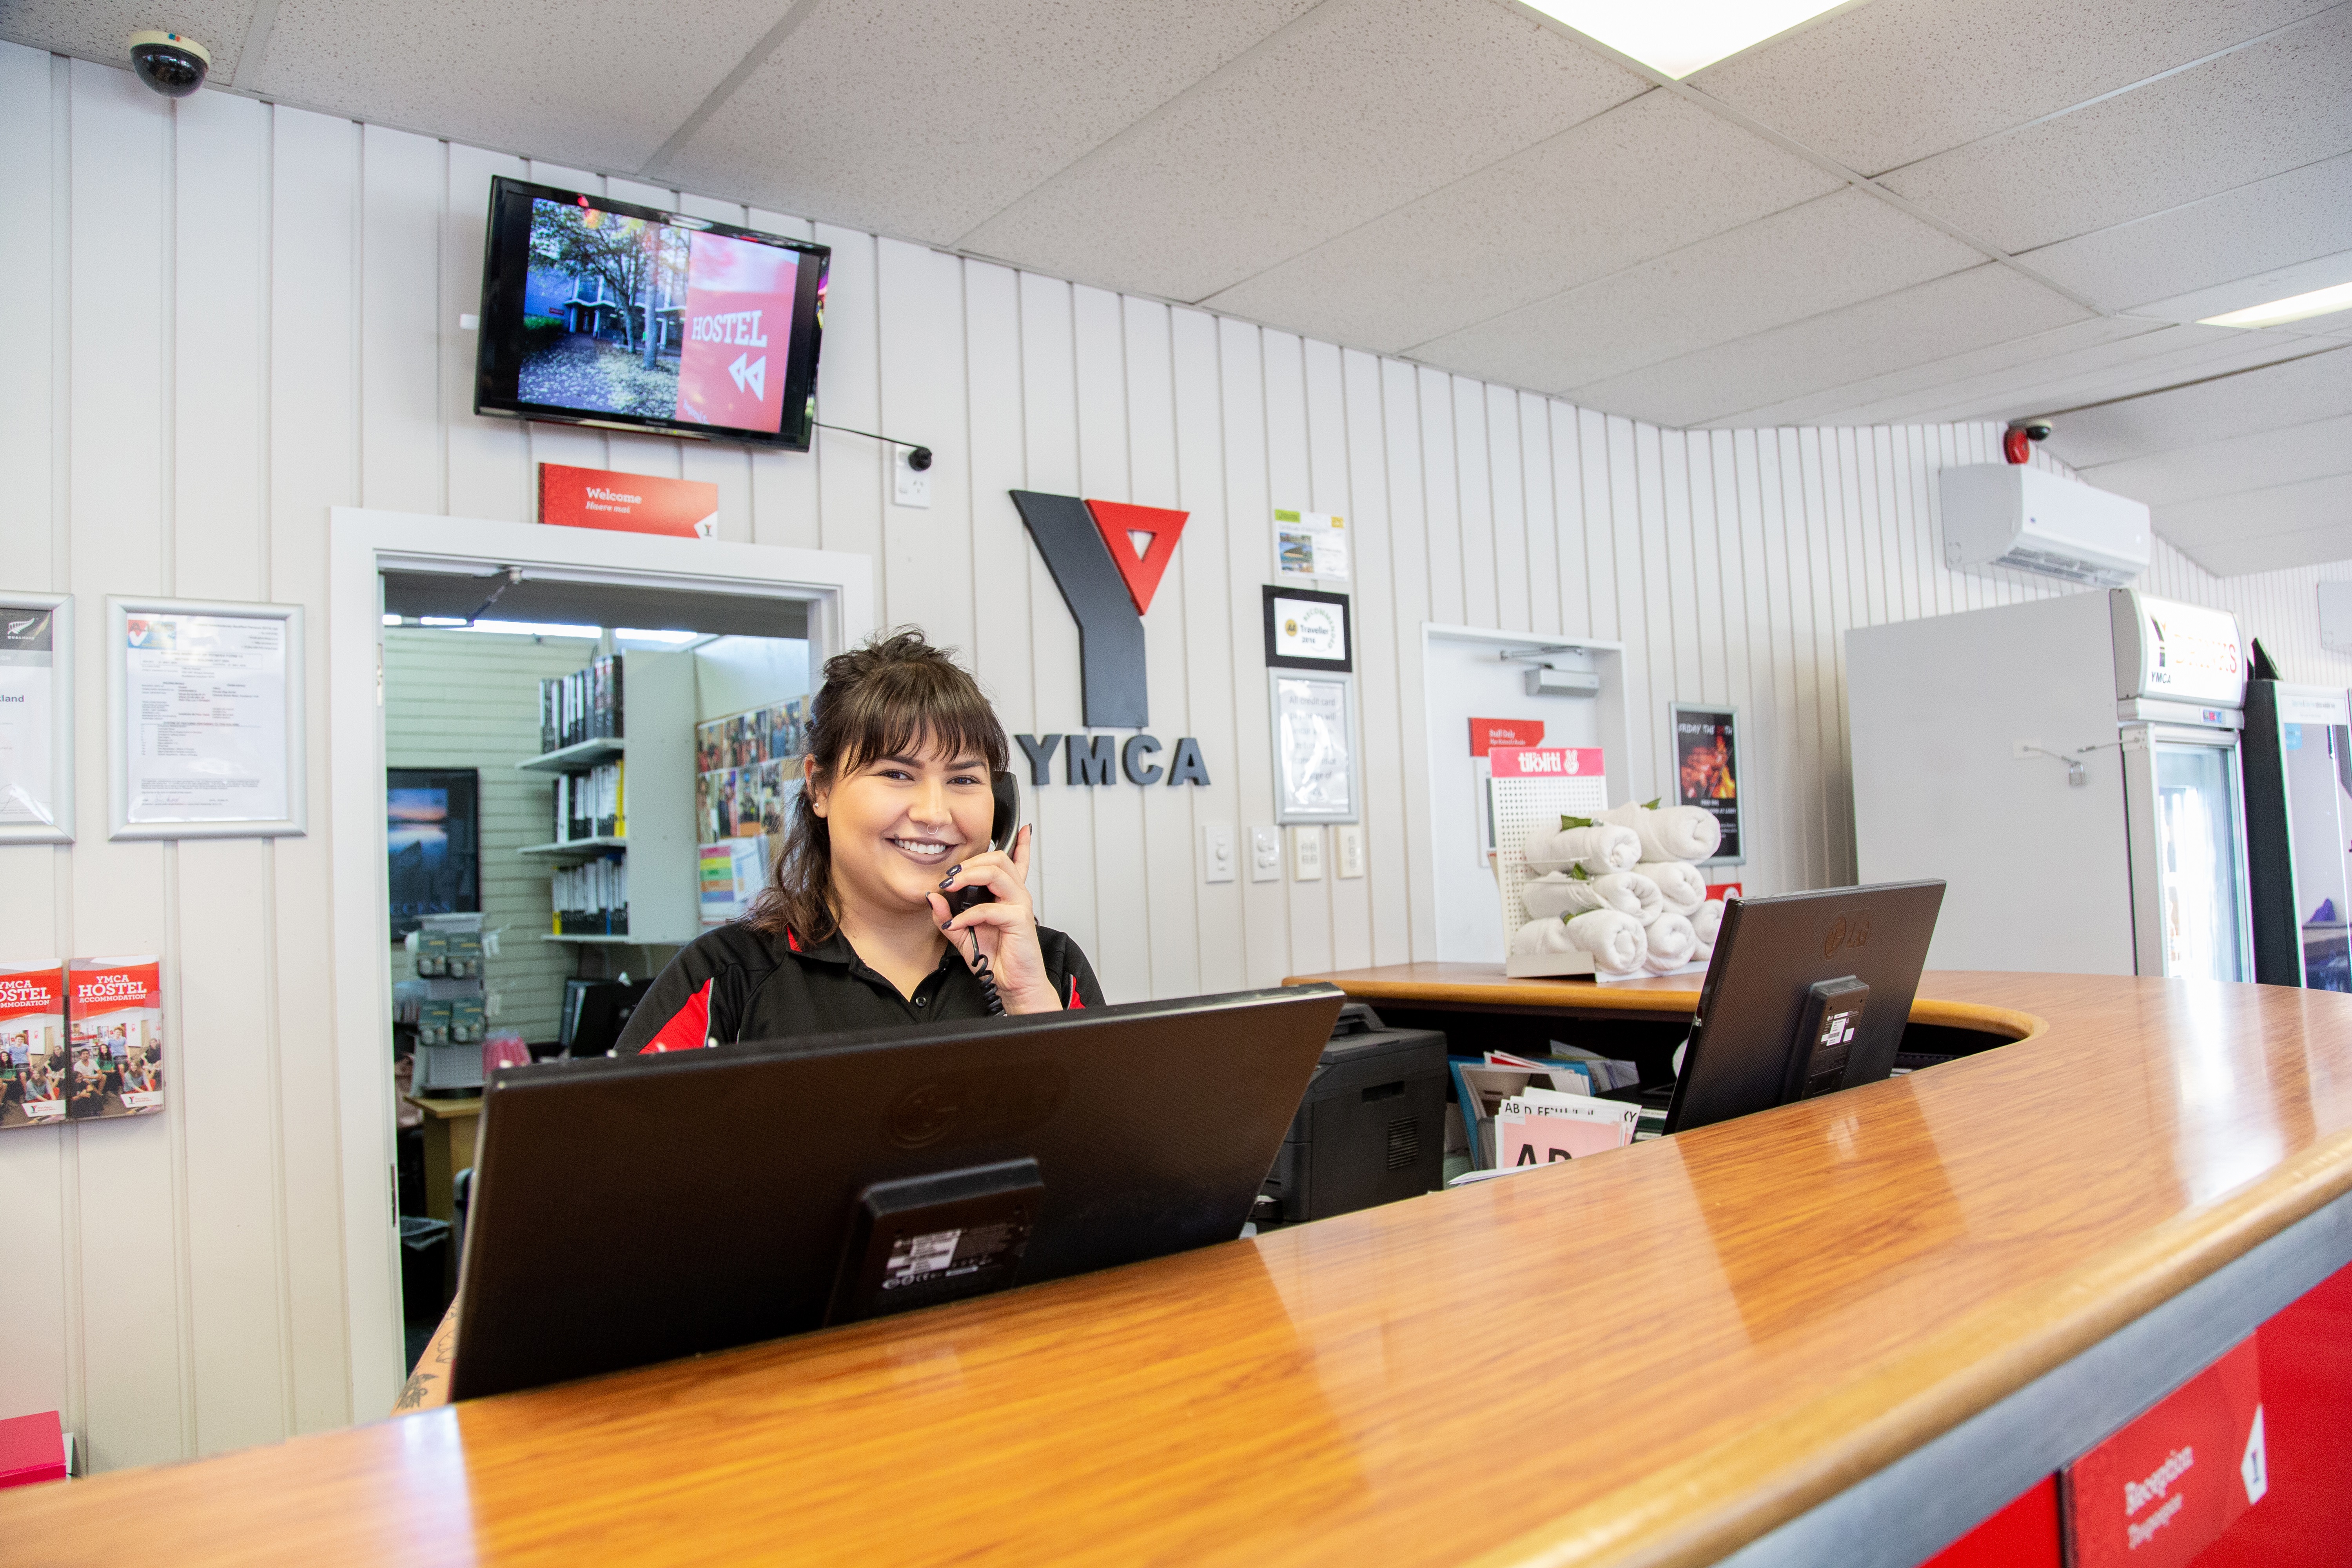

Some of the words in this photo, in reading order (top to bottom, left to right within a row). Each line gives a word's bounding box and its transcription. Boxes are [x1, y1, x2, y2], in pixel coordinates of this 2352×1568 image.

[691, 309, 768, 348] HOSTEL
[586, 486, 642, 504] Welcome
[586, 501, 612, 512] Haere
[1300, 624, 1328, 634] Traveller
[2151, 671, 2171, 684] YMCA
[1300, 696, 1319, 705] credit
[1321, 697, 1336, 706] card
[1678, 723, 1701, 735] FRIDAY
[1502, 730, 1515, 739] Only
[1014, 734, 1211, 786] YMCA
[0, 980, 32, 989] YMCA
[96, 975, 129, 984] YMCA
[78, 982, 147, 997] HOSTEL
[79, 994, 146, 1003] ACCOMMODATION
[0, 1000, 50, 1008] MMODATION
[1505, 1103, 1519, 1113] AB
[2125, 1446, 2194, 1516] Reception
